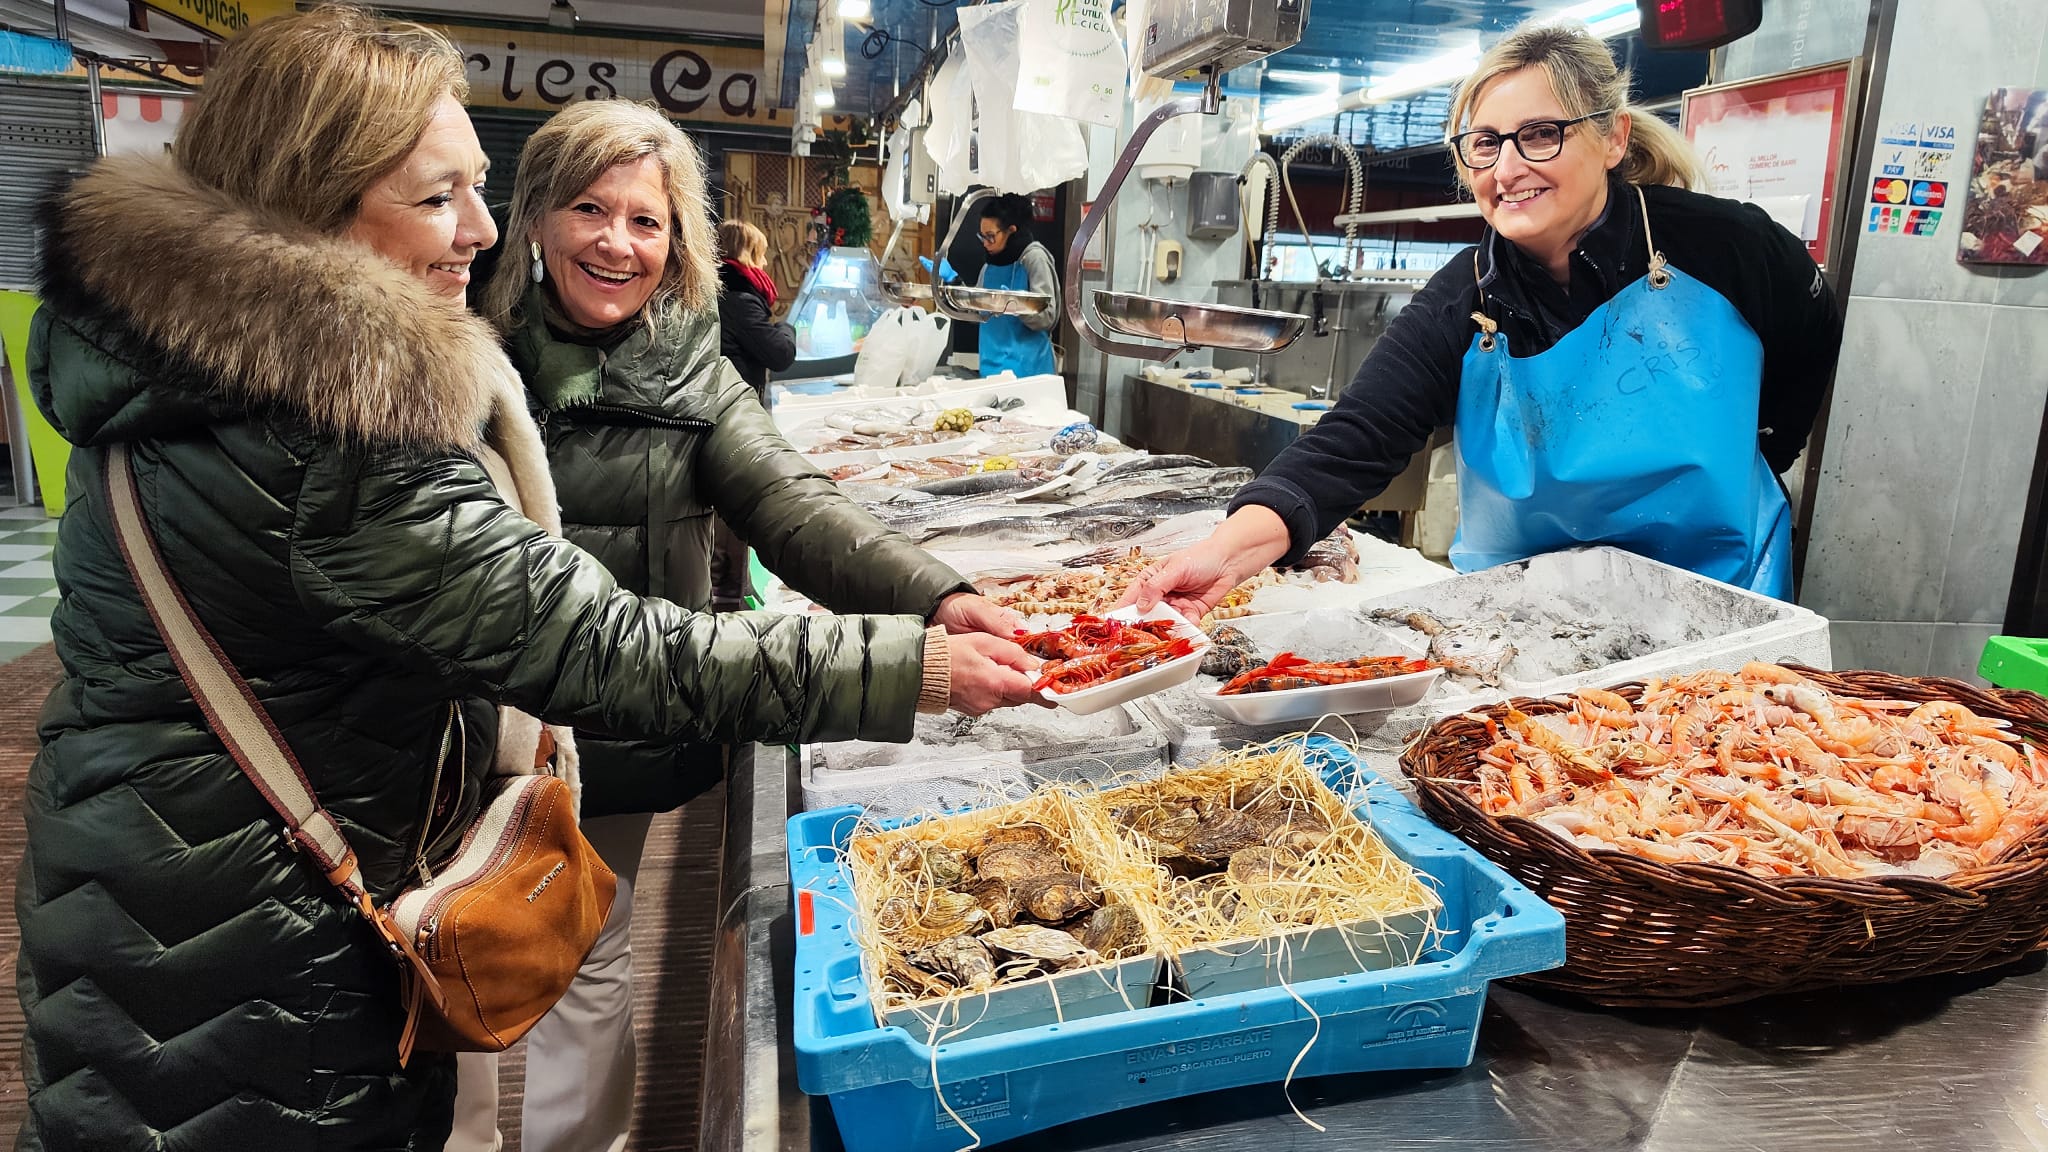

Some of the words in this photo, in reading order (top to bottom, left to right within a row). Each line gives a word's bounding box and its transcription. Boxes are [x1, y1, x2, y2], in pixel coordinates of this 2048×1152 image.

[1927, 125, 1955, 139] VISA
[1885, 166, 1901, 175] PAY
[1868, 213, 1900, 229] JCB
[1200, 1029, 1272, 1051] BARBATE
[1127, 1065, 1179, 1081] PROHIBIDO
[1179, 1060, 1214, 1073] SACAR
[1214, 1056, 1233, 1067] DEL
[1233, 1049, 1272, 1063] PUERTO
